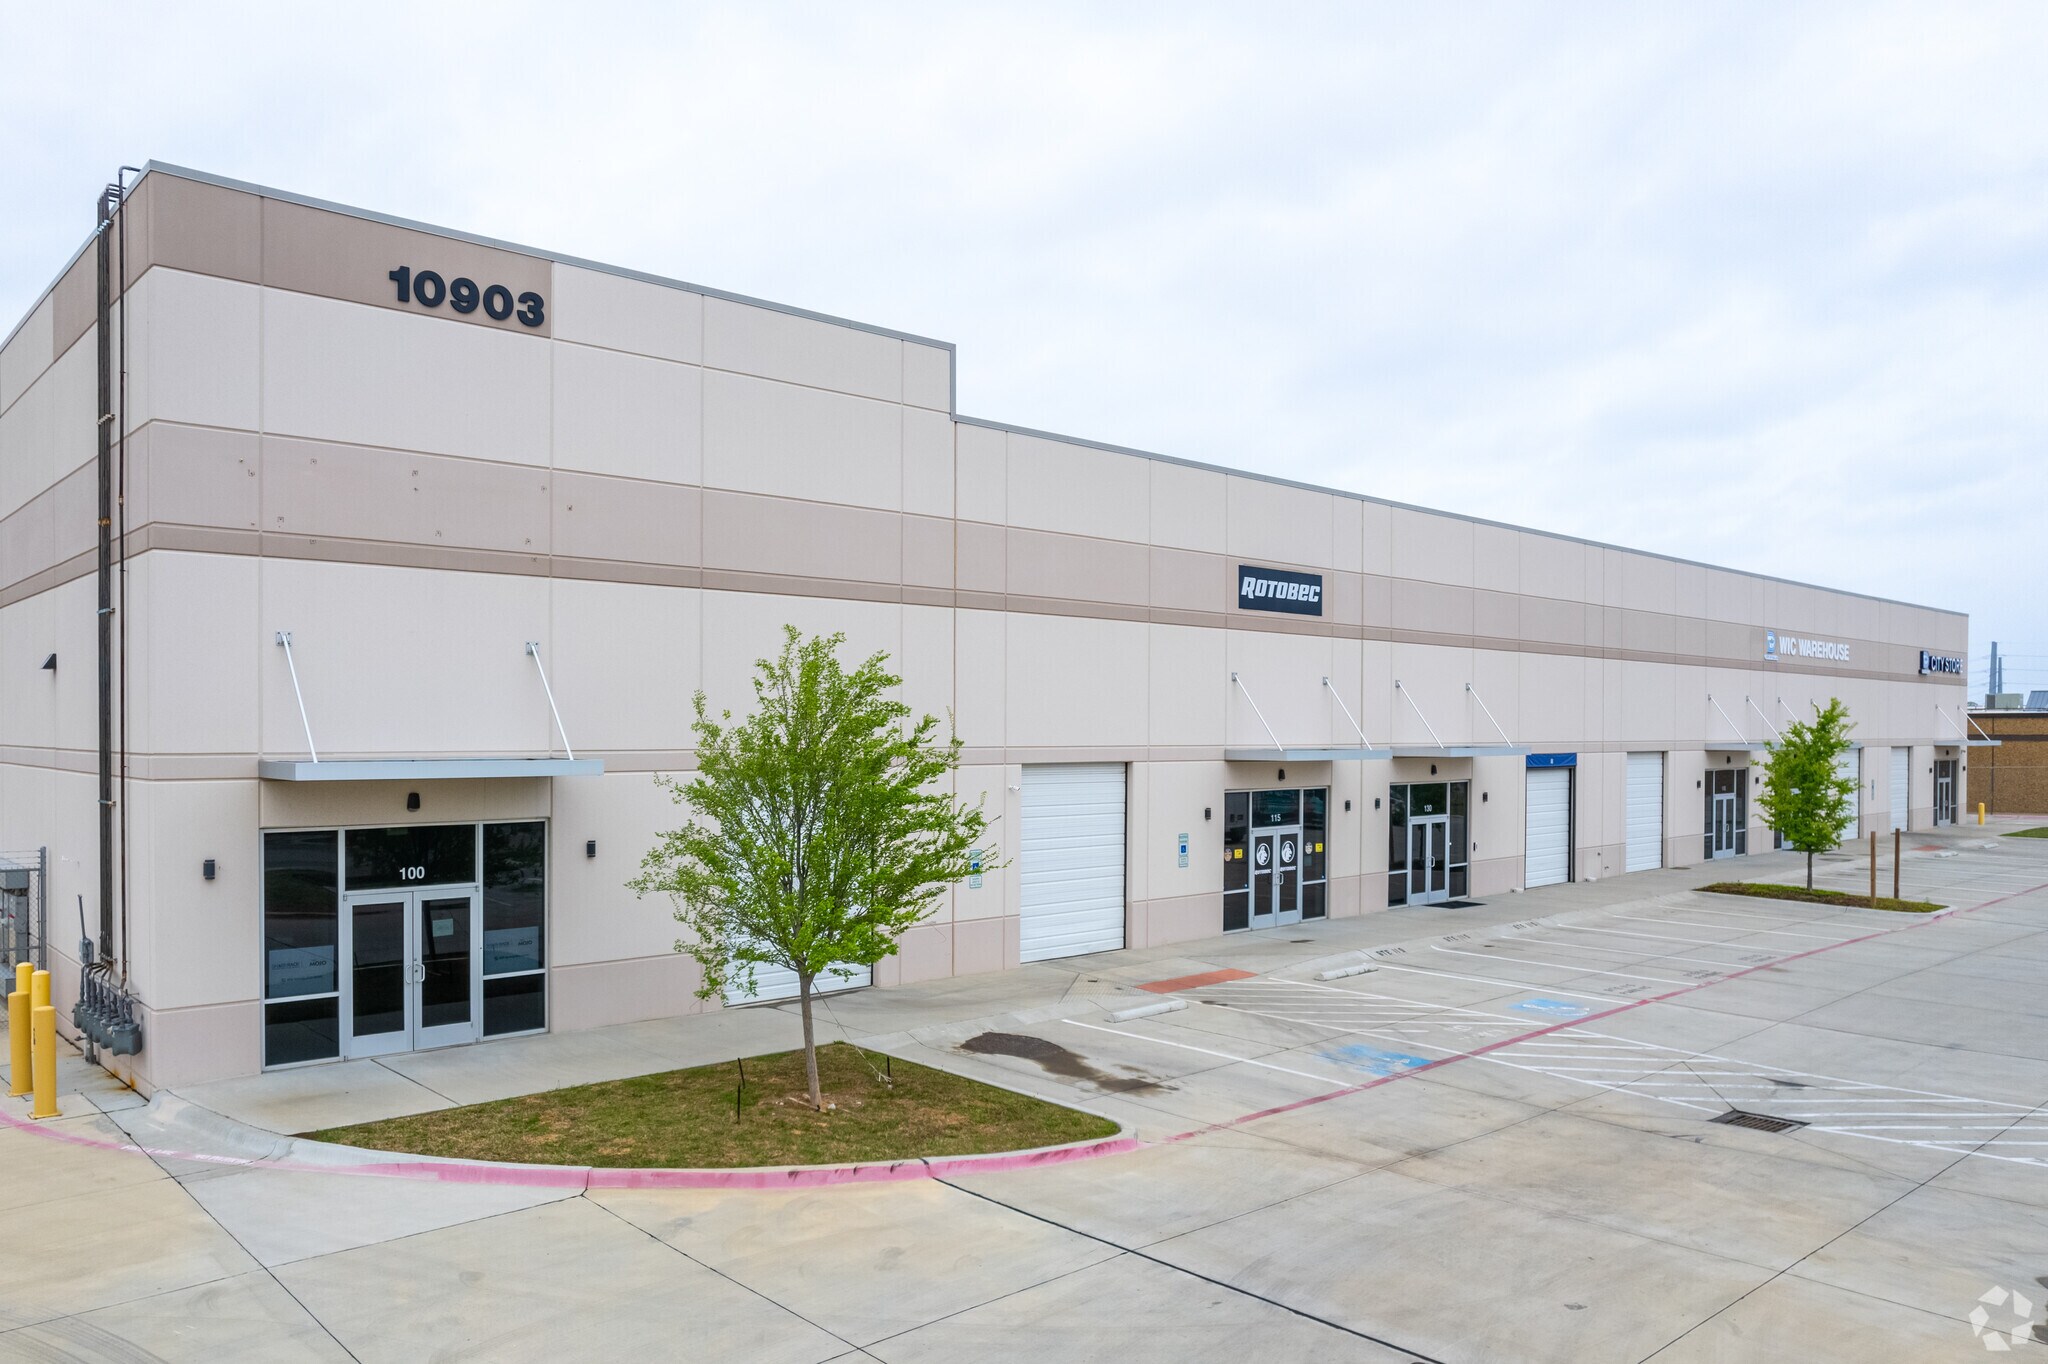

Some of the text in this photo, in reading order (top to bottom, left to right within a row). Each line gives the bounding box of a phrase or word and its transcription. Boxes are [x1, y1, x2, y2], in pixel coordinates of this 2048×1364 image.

[389, 265, 545, 327] 10903
[1779, 636, 1850, 661] WIC WAREHOUSE
[1931, 656, 1963, 673] CITY STORE
[1270, 813, 1282, 823] 115
[399, 866, 425, 880] 100
